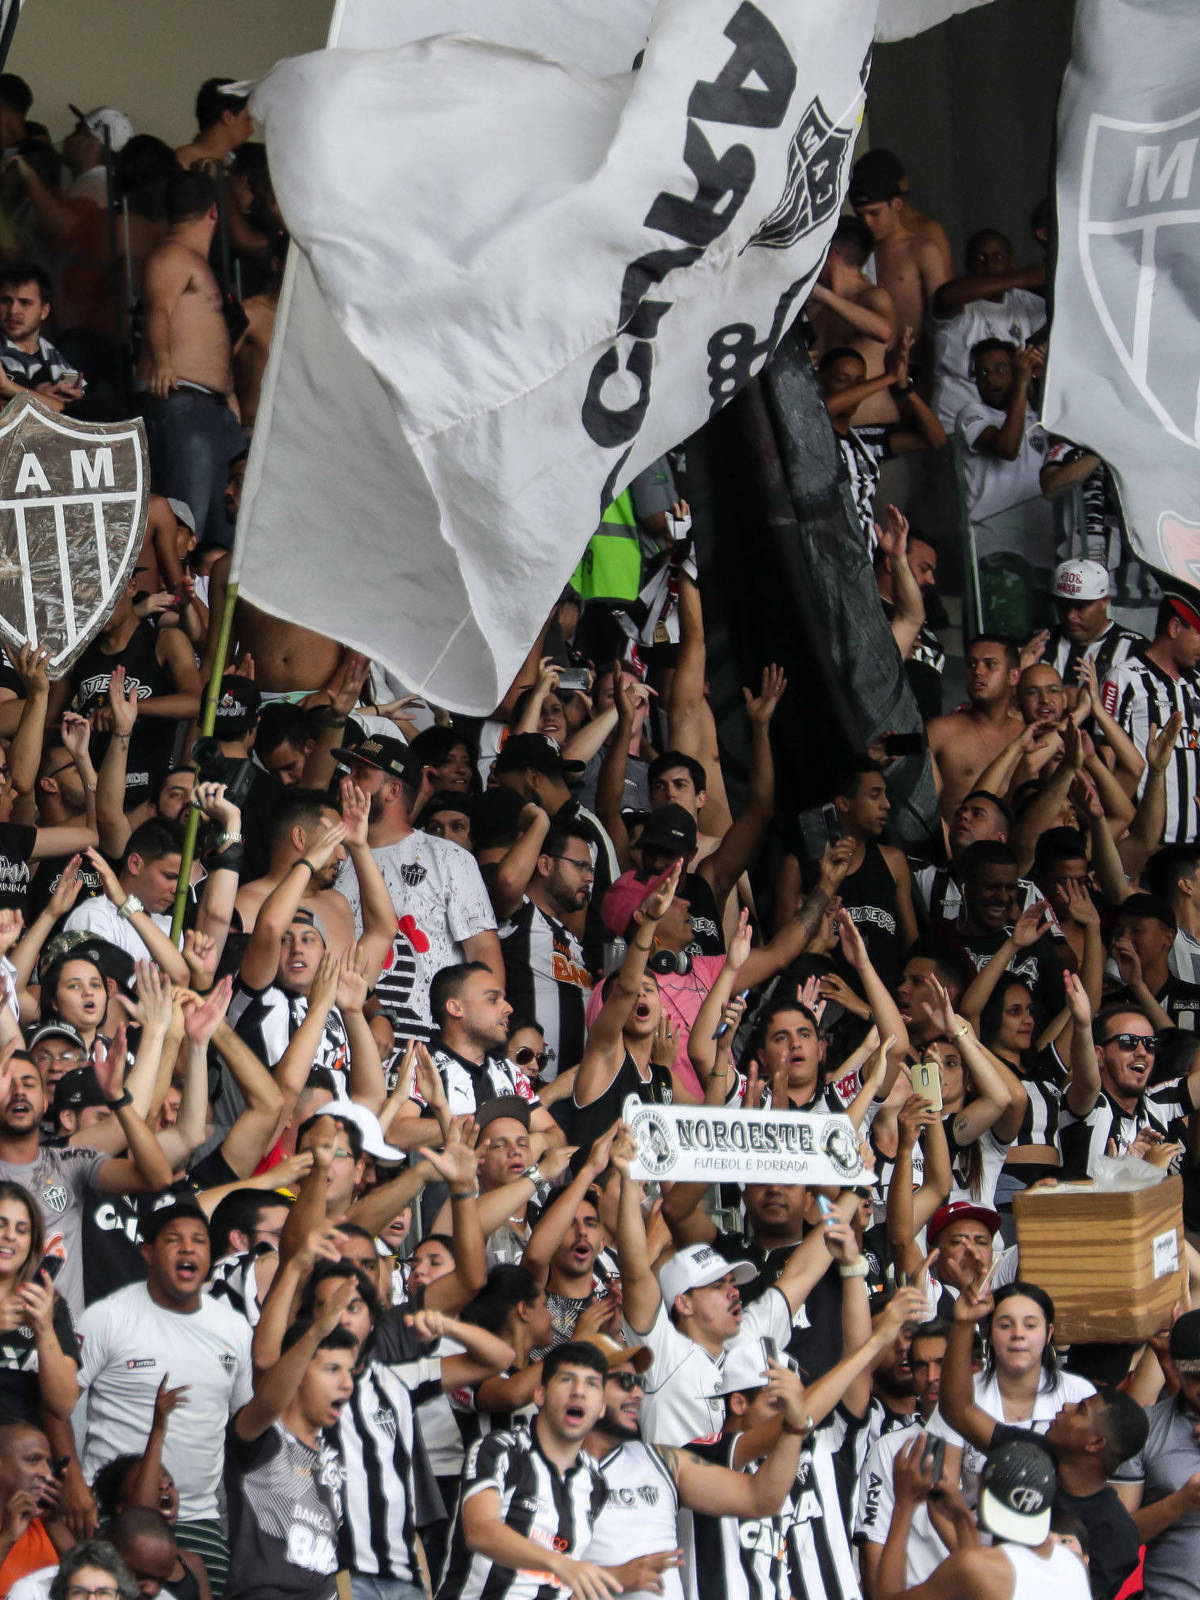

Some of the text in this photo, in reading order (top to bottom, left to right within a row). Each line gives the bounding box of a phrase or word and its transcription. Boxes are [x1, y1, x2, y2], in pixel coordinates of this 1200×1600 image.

[676, 1118, 818, 1155] NOROESTE
[694, 1157, 742, 1171] FUTEBOL
[863, 1472, 883, 1527] MRV
[293, 1503, 332, 1531] BANCO
